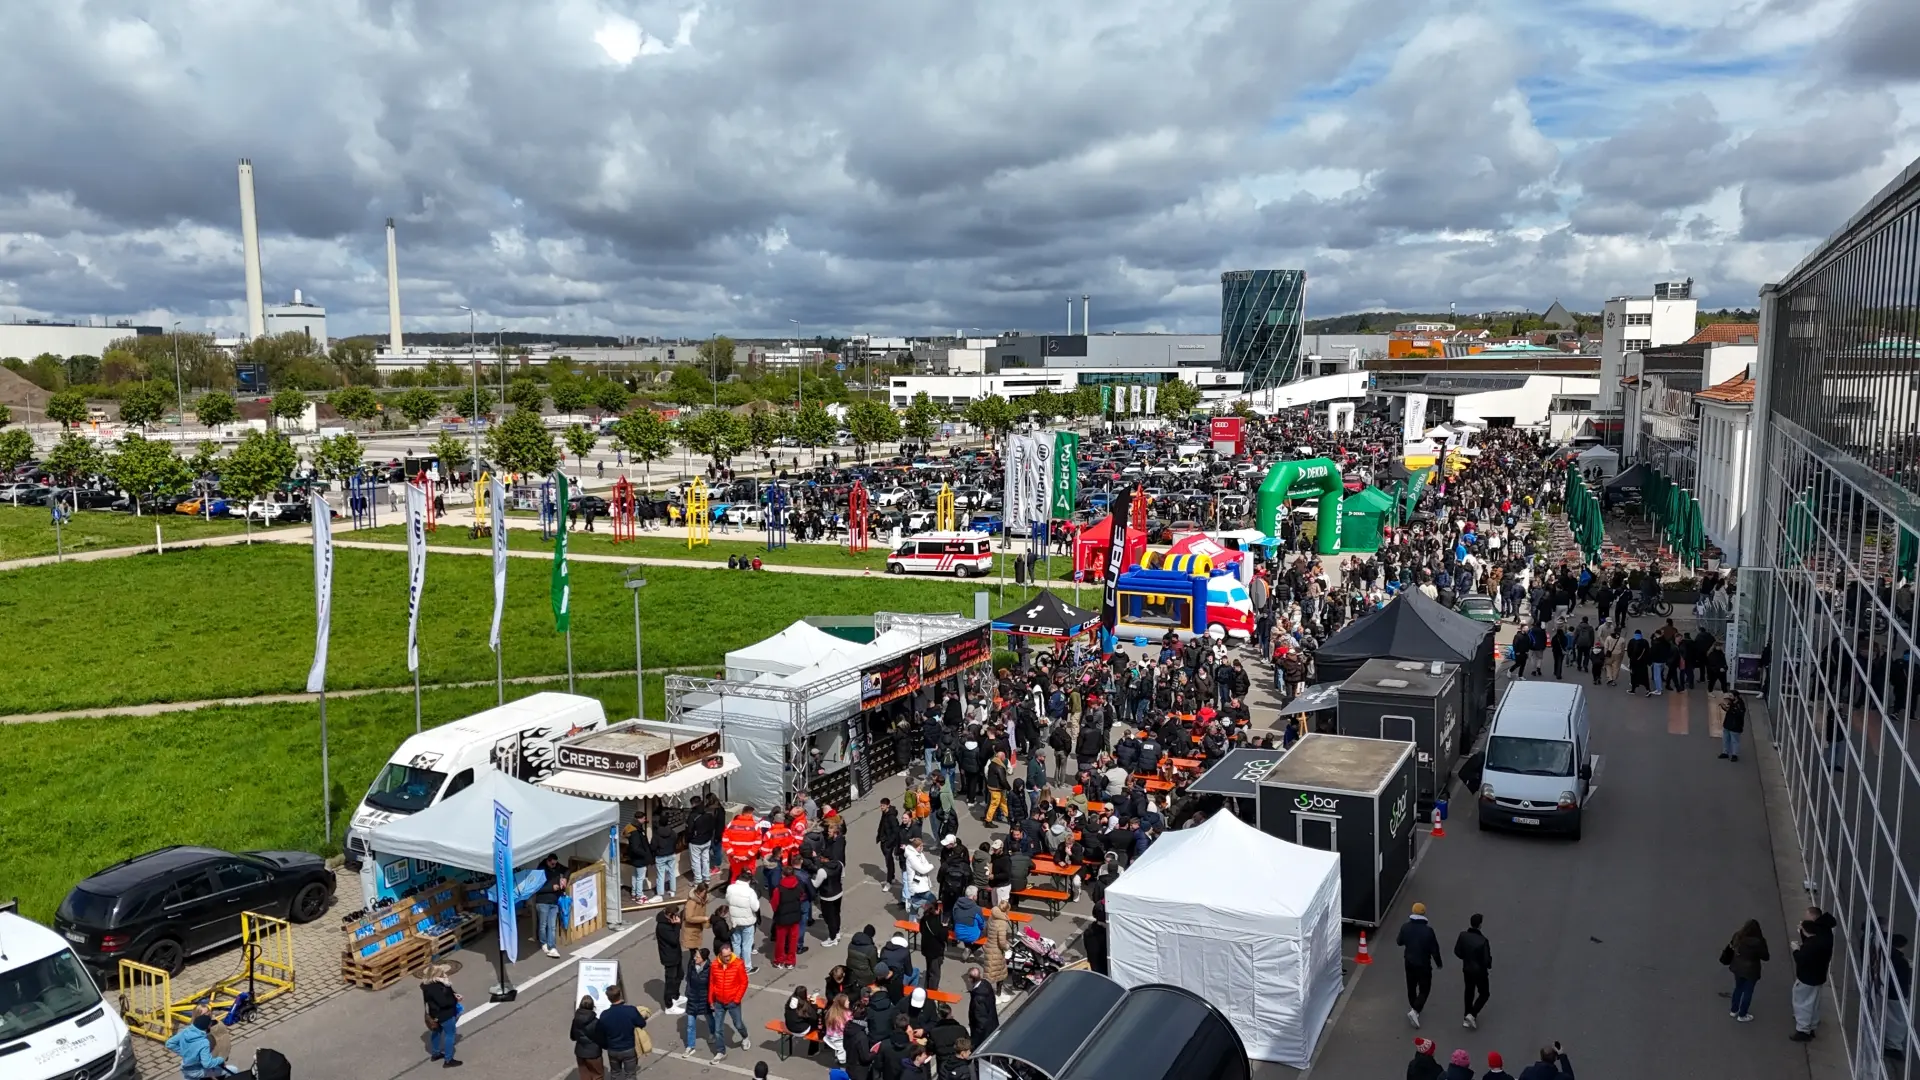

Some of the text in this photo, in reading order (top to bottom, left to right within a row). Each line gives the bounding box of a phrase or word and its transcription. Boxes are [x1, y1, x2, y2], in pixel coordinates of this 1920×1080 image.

[1059, 443, 1072, 490] DEKRA
[1306, 465, 1328, 479] DEKRA
[1035, 464, 1045, 513] Allianz
[1413, 473, 1427, 492] DEKRA
[1275, 503, 1288, 540] EKRA
[1335, 494, 1344, 534] DEKRA
[1105, 524, 1125, 607] CUBE
[1018, 624, 1064, 636] CUBE
[1083, 615, 1101, 629] CUBE
[559, 749, 610, 770] CREPES
[625, 759, 638, 772] go!
